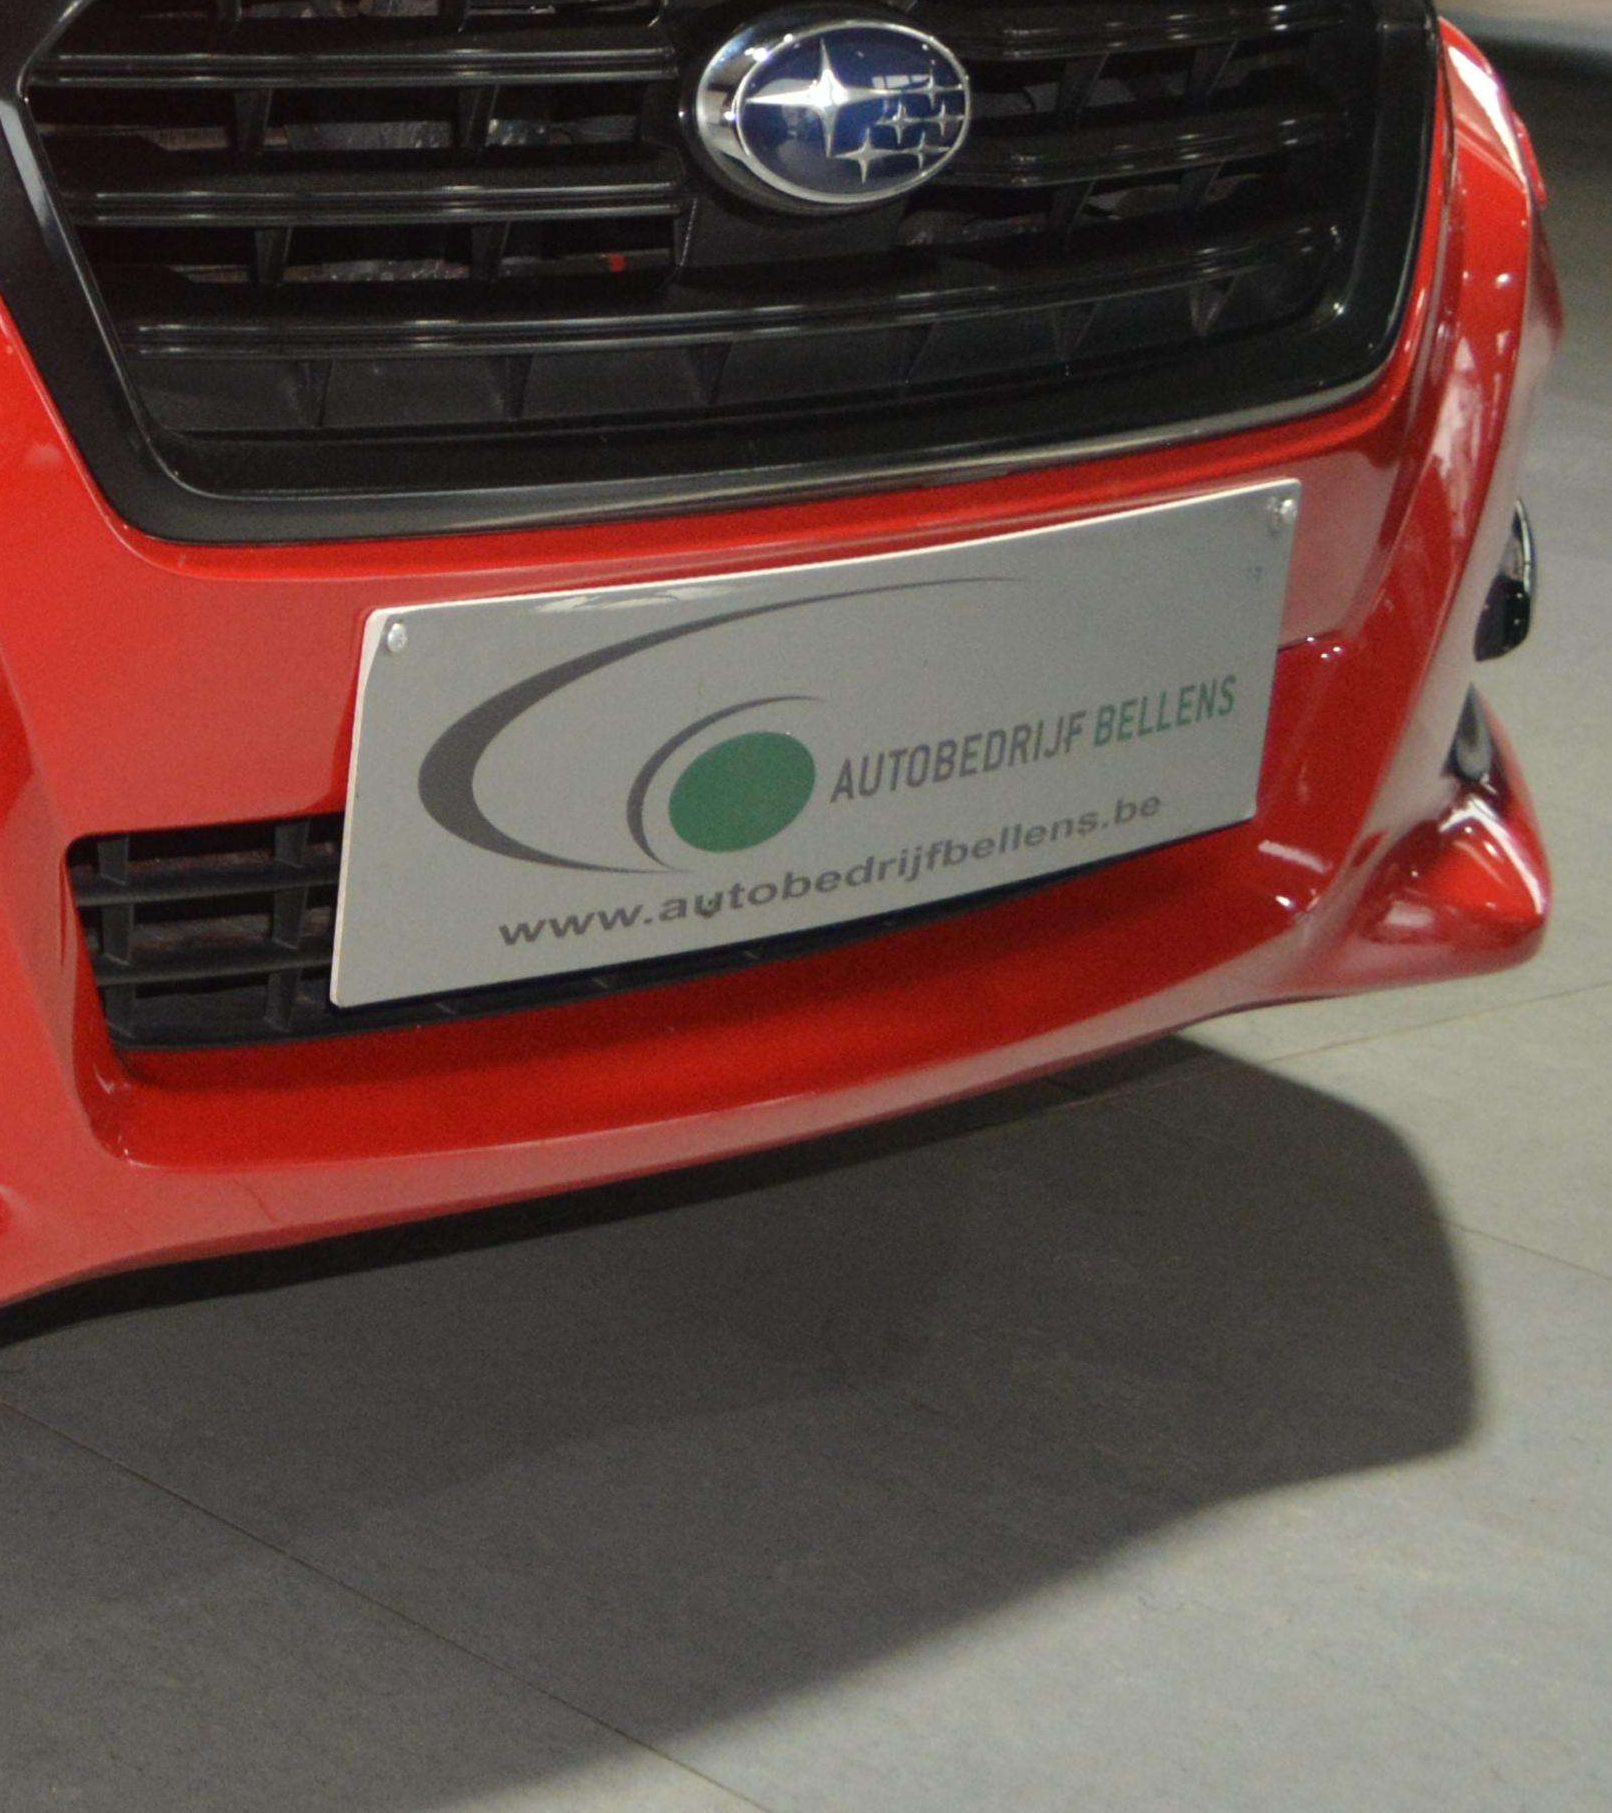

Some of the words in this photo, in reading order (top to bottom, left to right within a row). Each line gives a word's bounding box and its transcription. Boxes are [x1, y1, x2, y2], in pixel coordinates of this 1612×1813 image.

[829, 709, 1087, 804] AUTOBEDRIJF
[1093, 674, 1237, 748] BELLENS
[498, 795, 1161, 946] www.autobedrijfbellens.be
